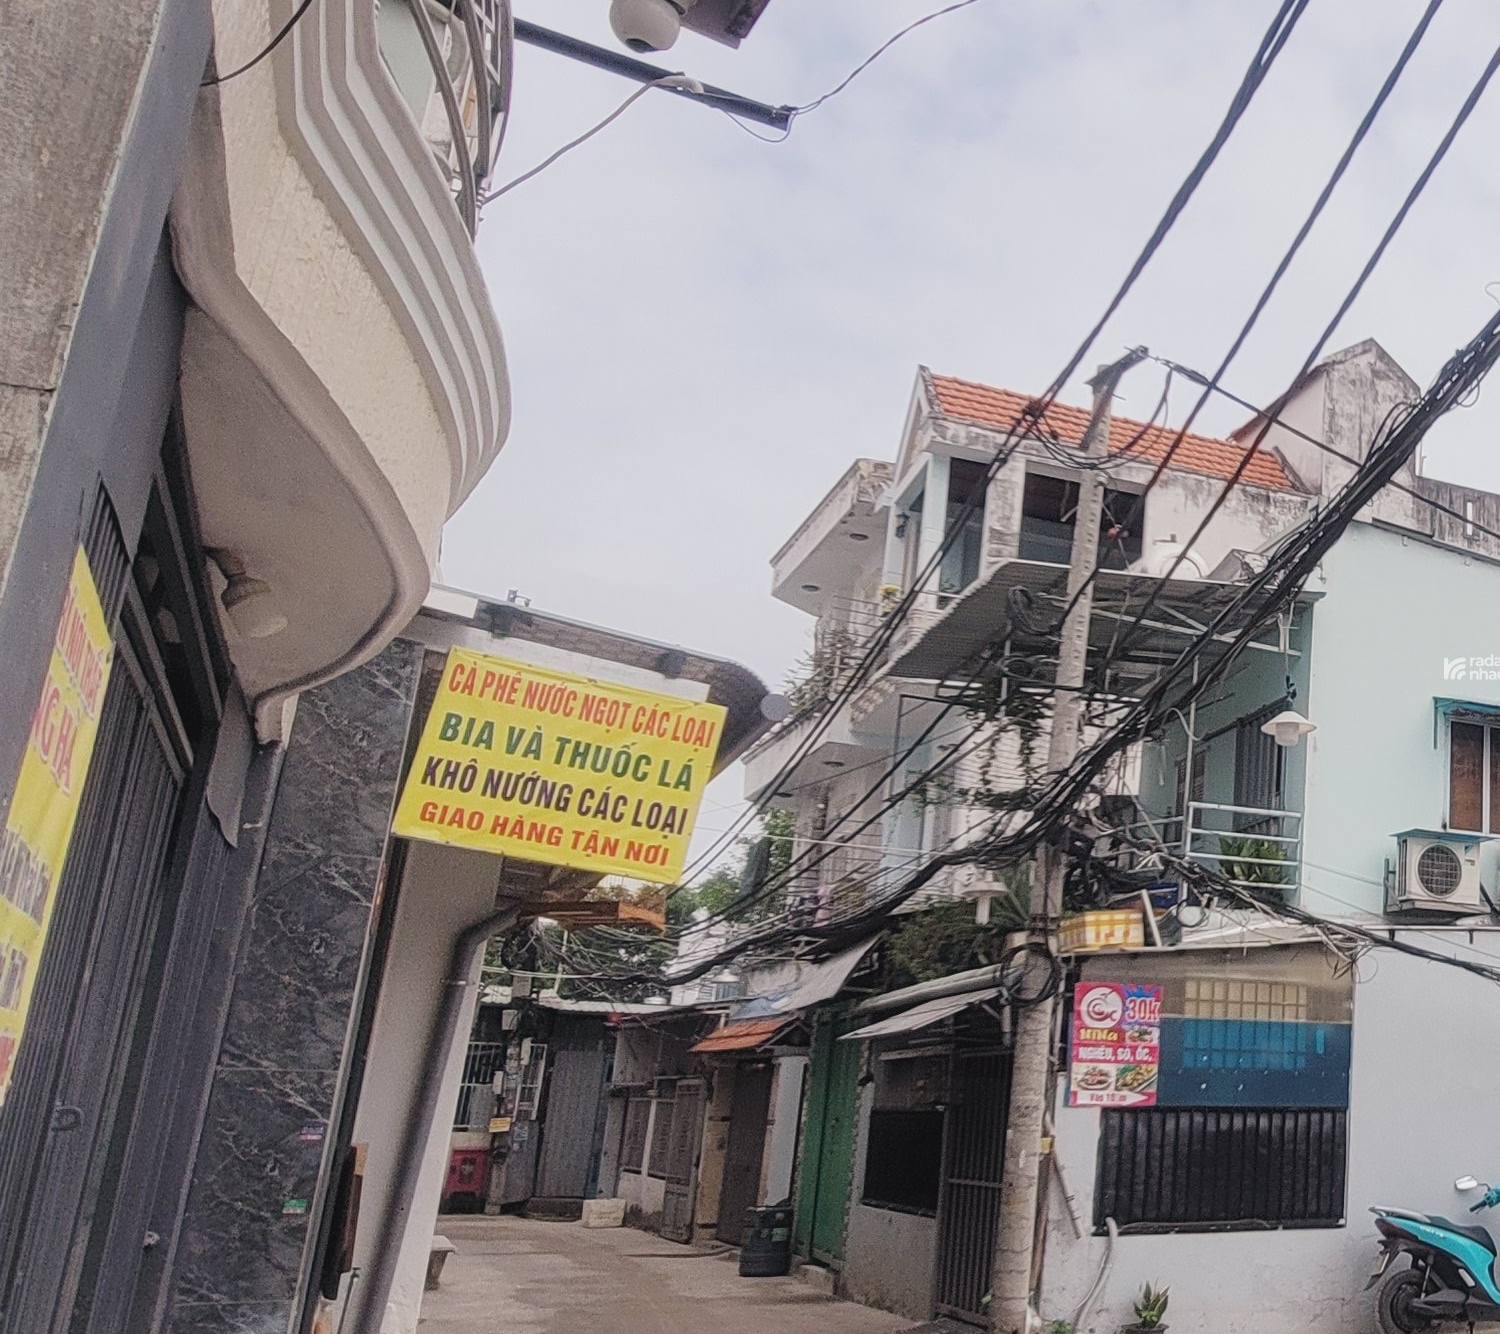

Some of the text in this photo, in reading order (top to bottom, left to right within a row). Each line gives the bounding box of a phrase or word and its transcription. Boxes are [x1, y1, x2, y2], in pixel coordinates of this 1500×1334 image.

[448, 661, 716, 752] CÀ PHÊ NƯỚC NGỌT CÁC LOẠI
[438, 712, 695, 792] BIA VÀ THUỐC LÁ
[419, 801, 669, 866] GIAO HÀNG TẬN NƠI
[421, 756, 688, 839] KHÔ NƯỚNG CÁC LOẠI
